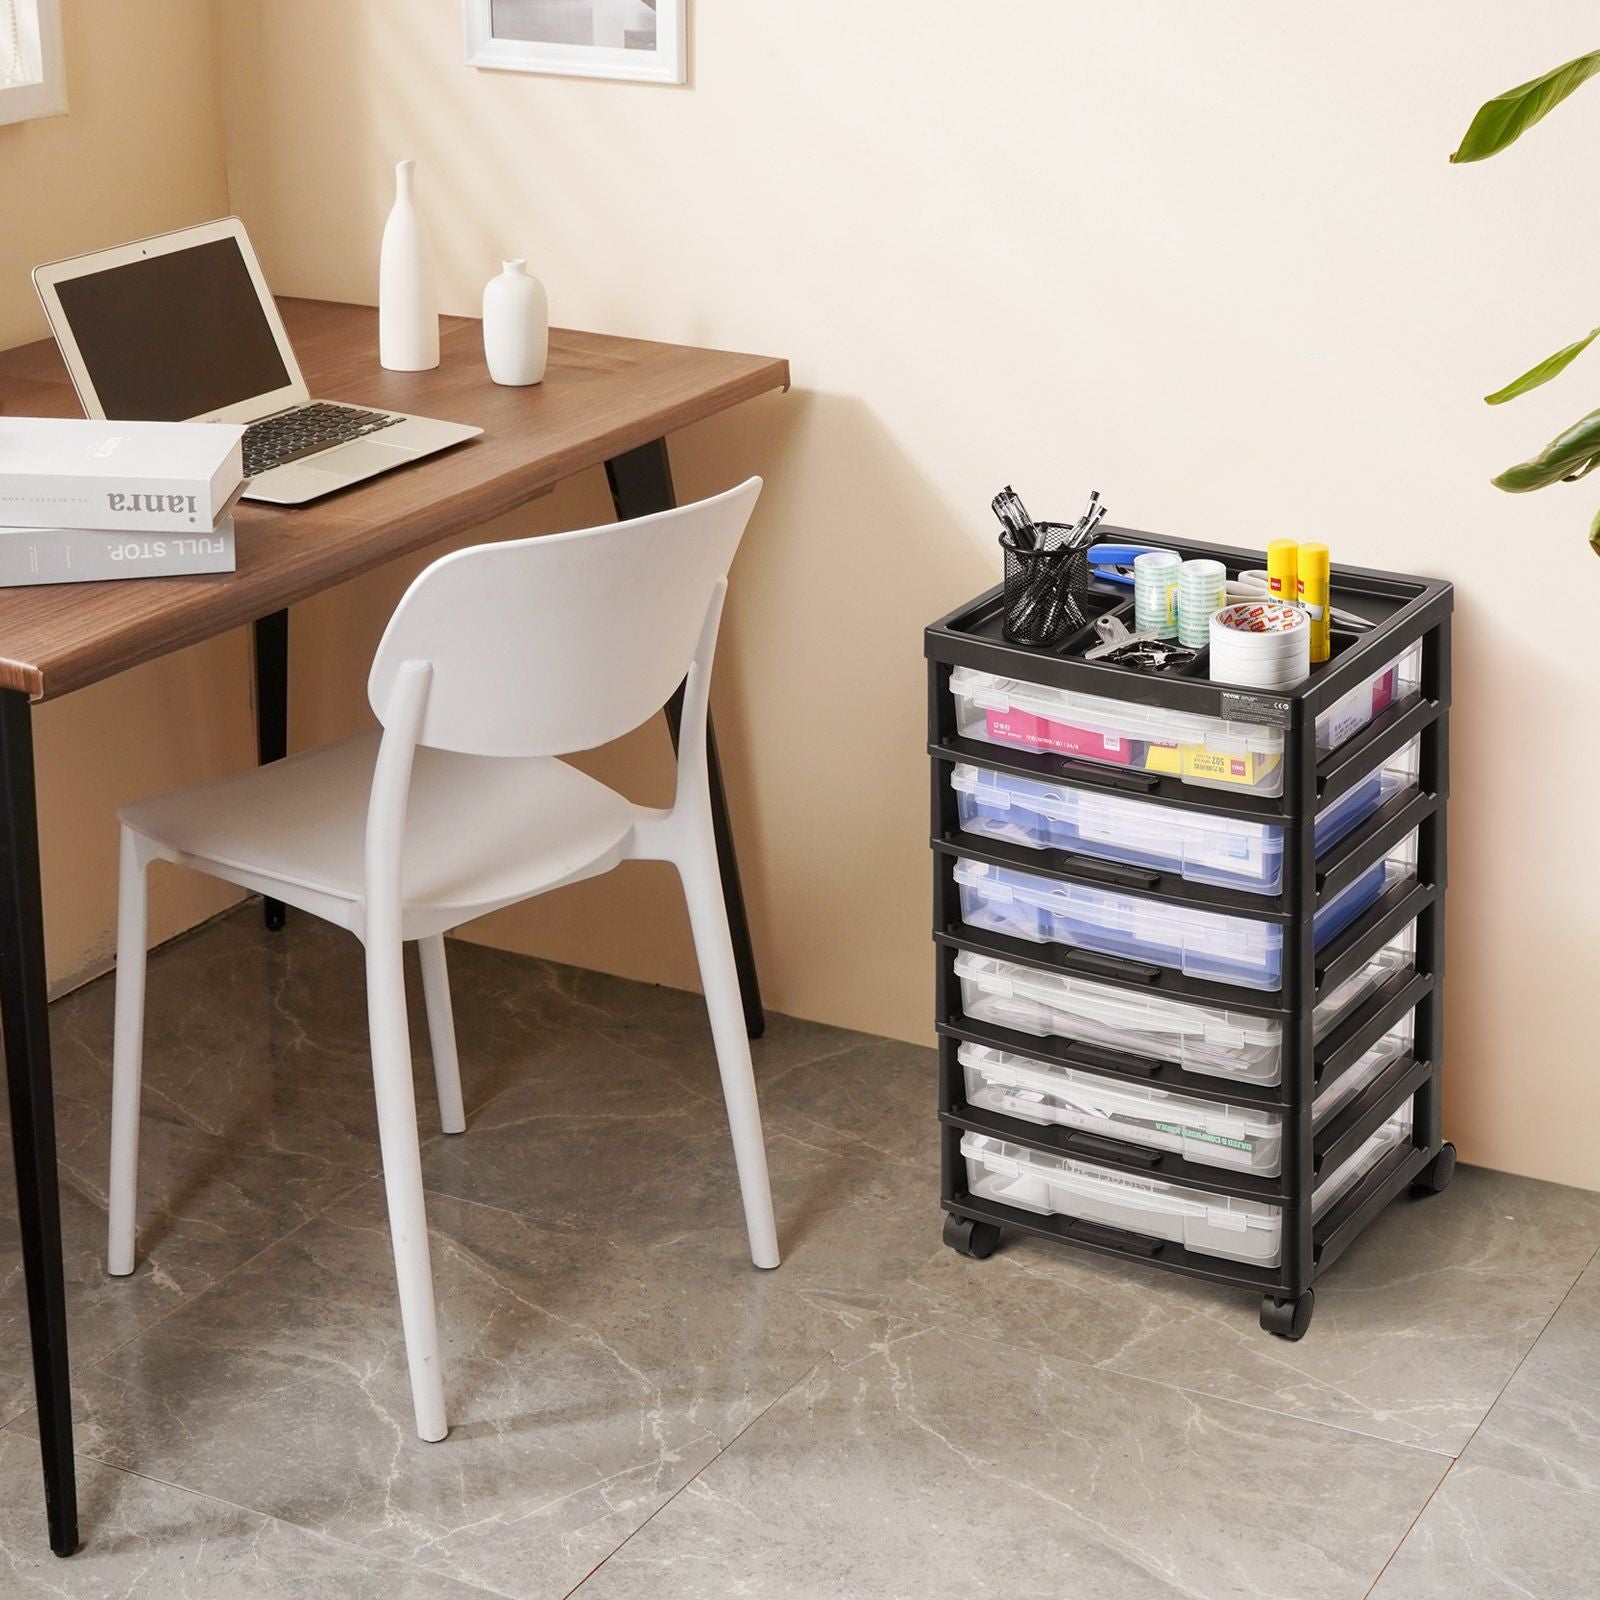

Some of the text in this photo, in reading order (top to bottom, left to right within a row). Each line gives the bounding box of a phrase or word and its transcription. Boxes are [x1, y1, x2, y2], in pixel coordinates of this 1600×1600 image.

[106, 492, 197, 524] ianra
[107, 537, 226, 561] FULL STOP.
[1211, 756, 1225, 766] 502
[1182, 1129, 1221, 1144] CONFUSED
[1227, 1139, 1252, 1151] DAZED
